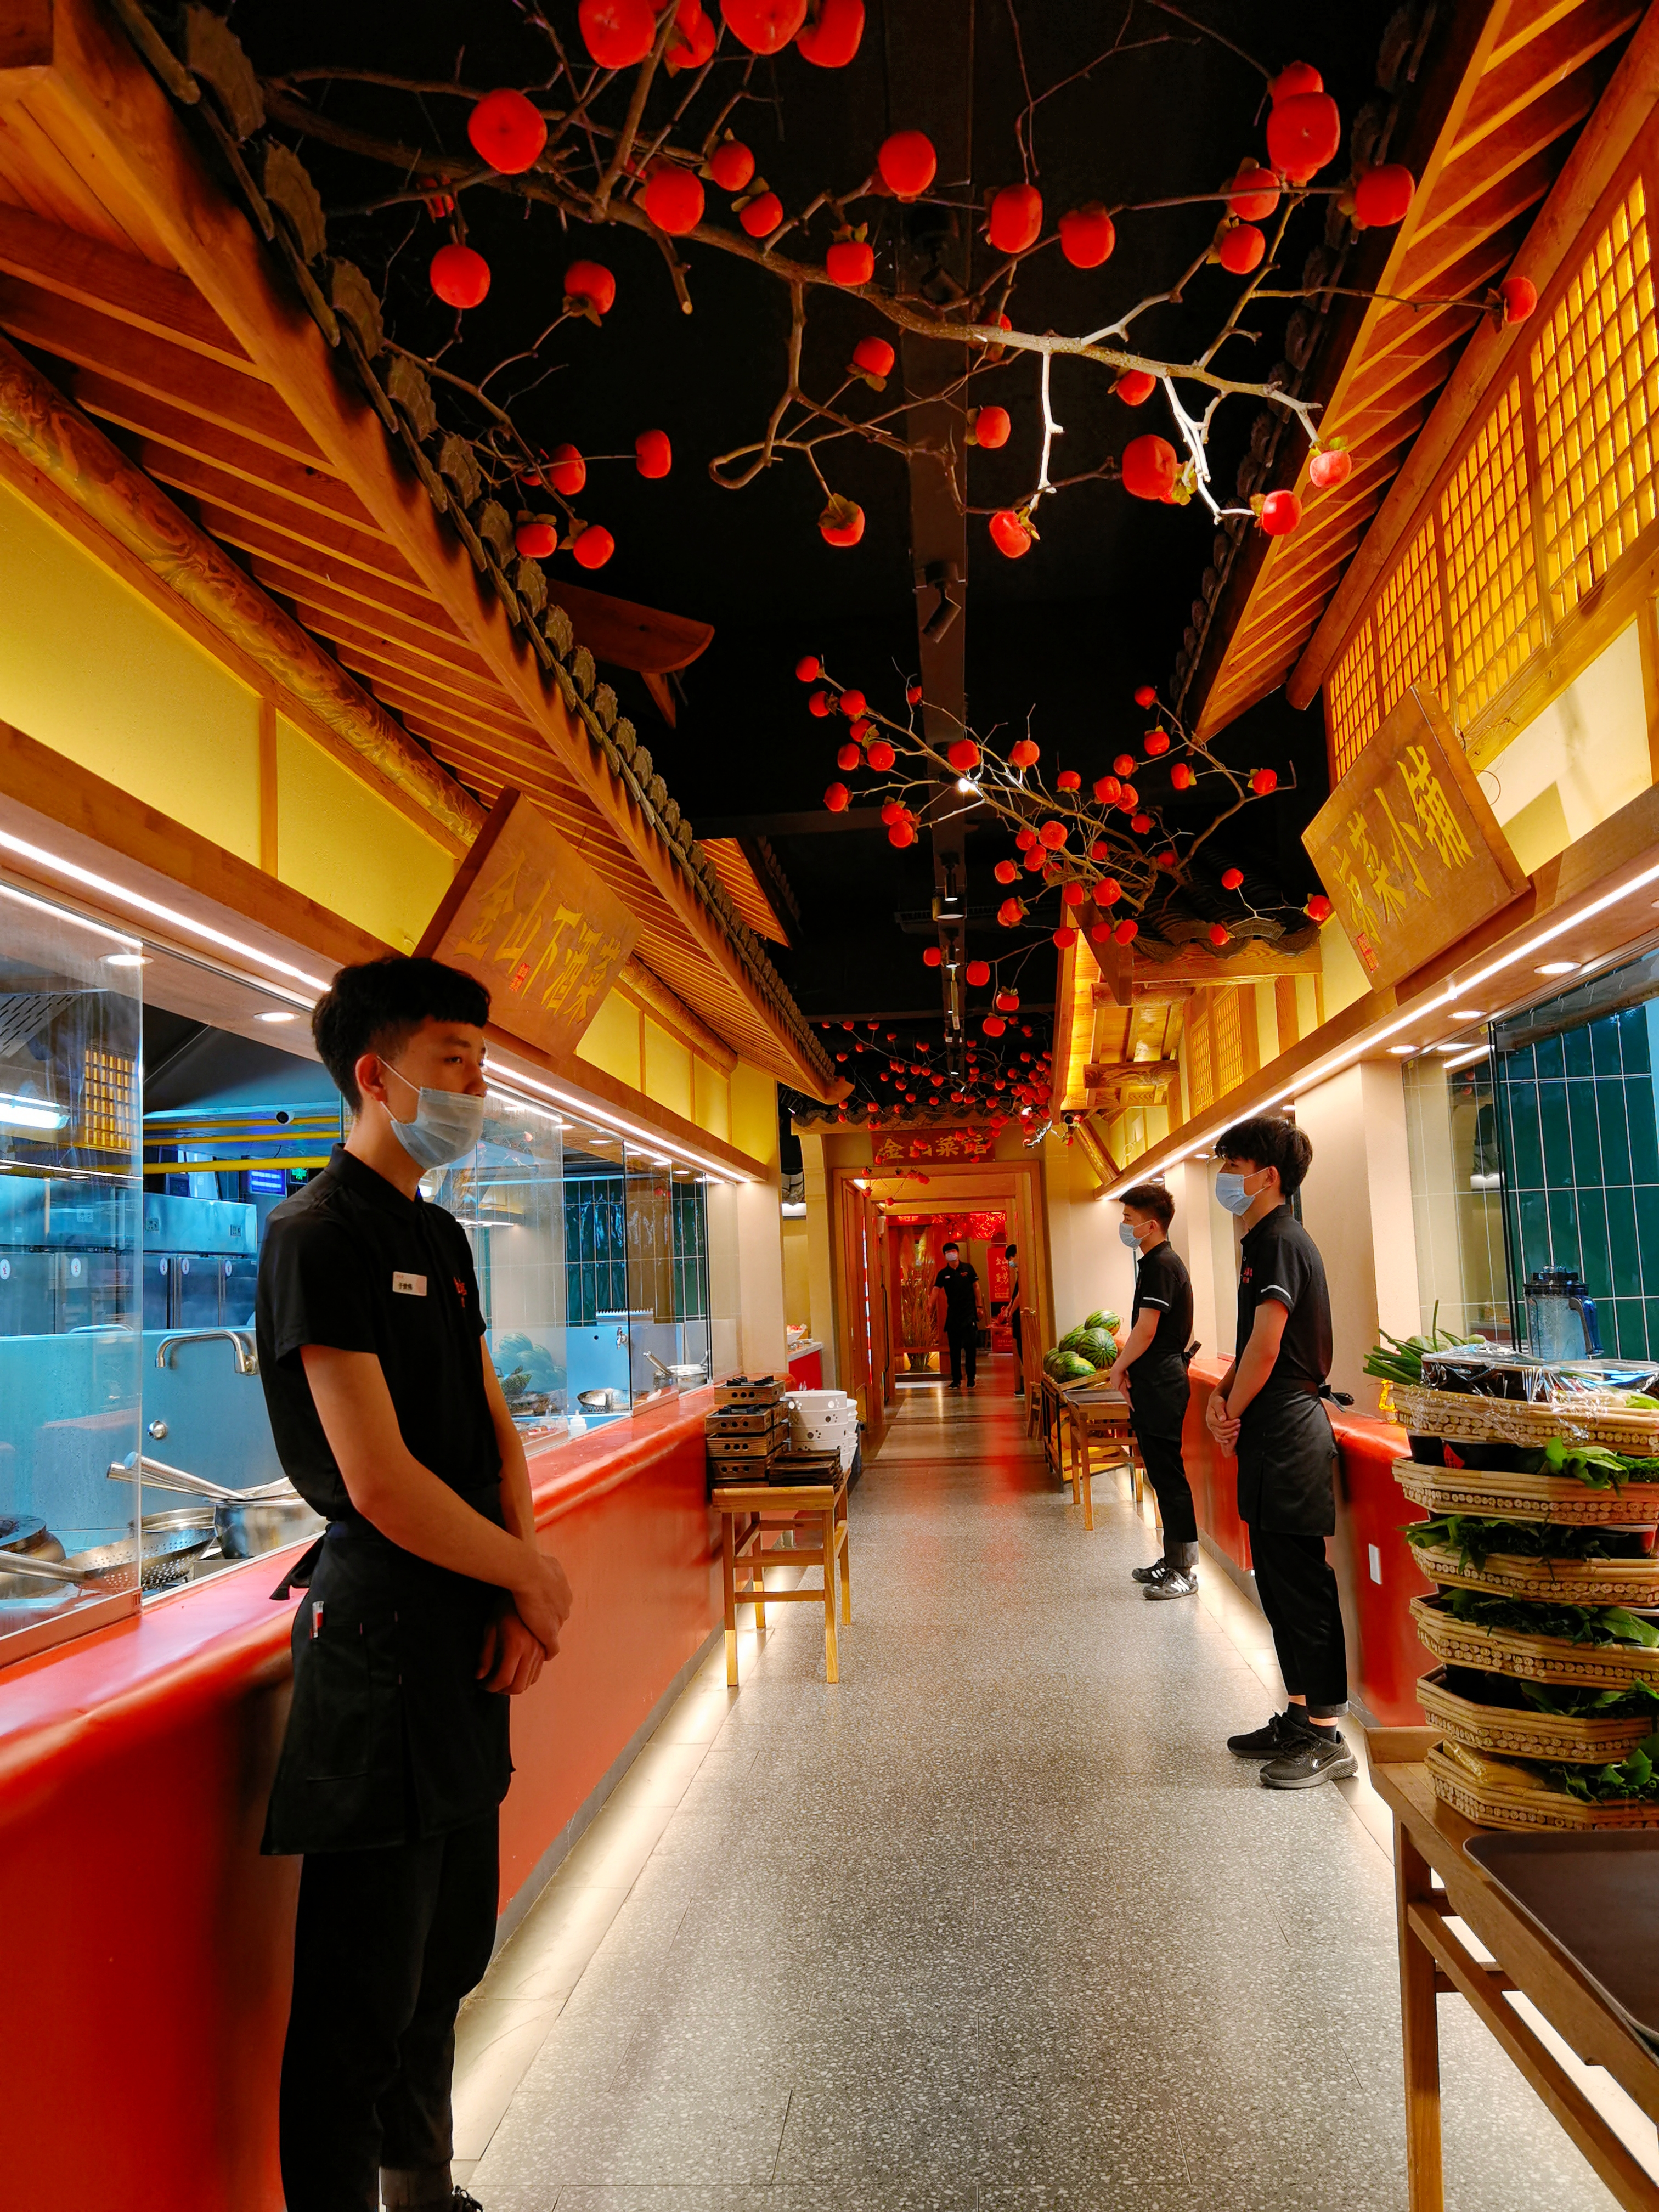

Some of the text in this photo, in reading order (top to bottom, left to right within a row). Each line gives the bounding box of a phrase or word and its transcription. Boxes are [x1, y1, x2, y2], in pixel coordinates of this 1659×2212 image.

[454, 850, 620, 1026] 金山下酒菜
[1331, 746, 1474, 944] 凉菜小铺
